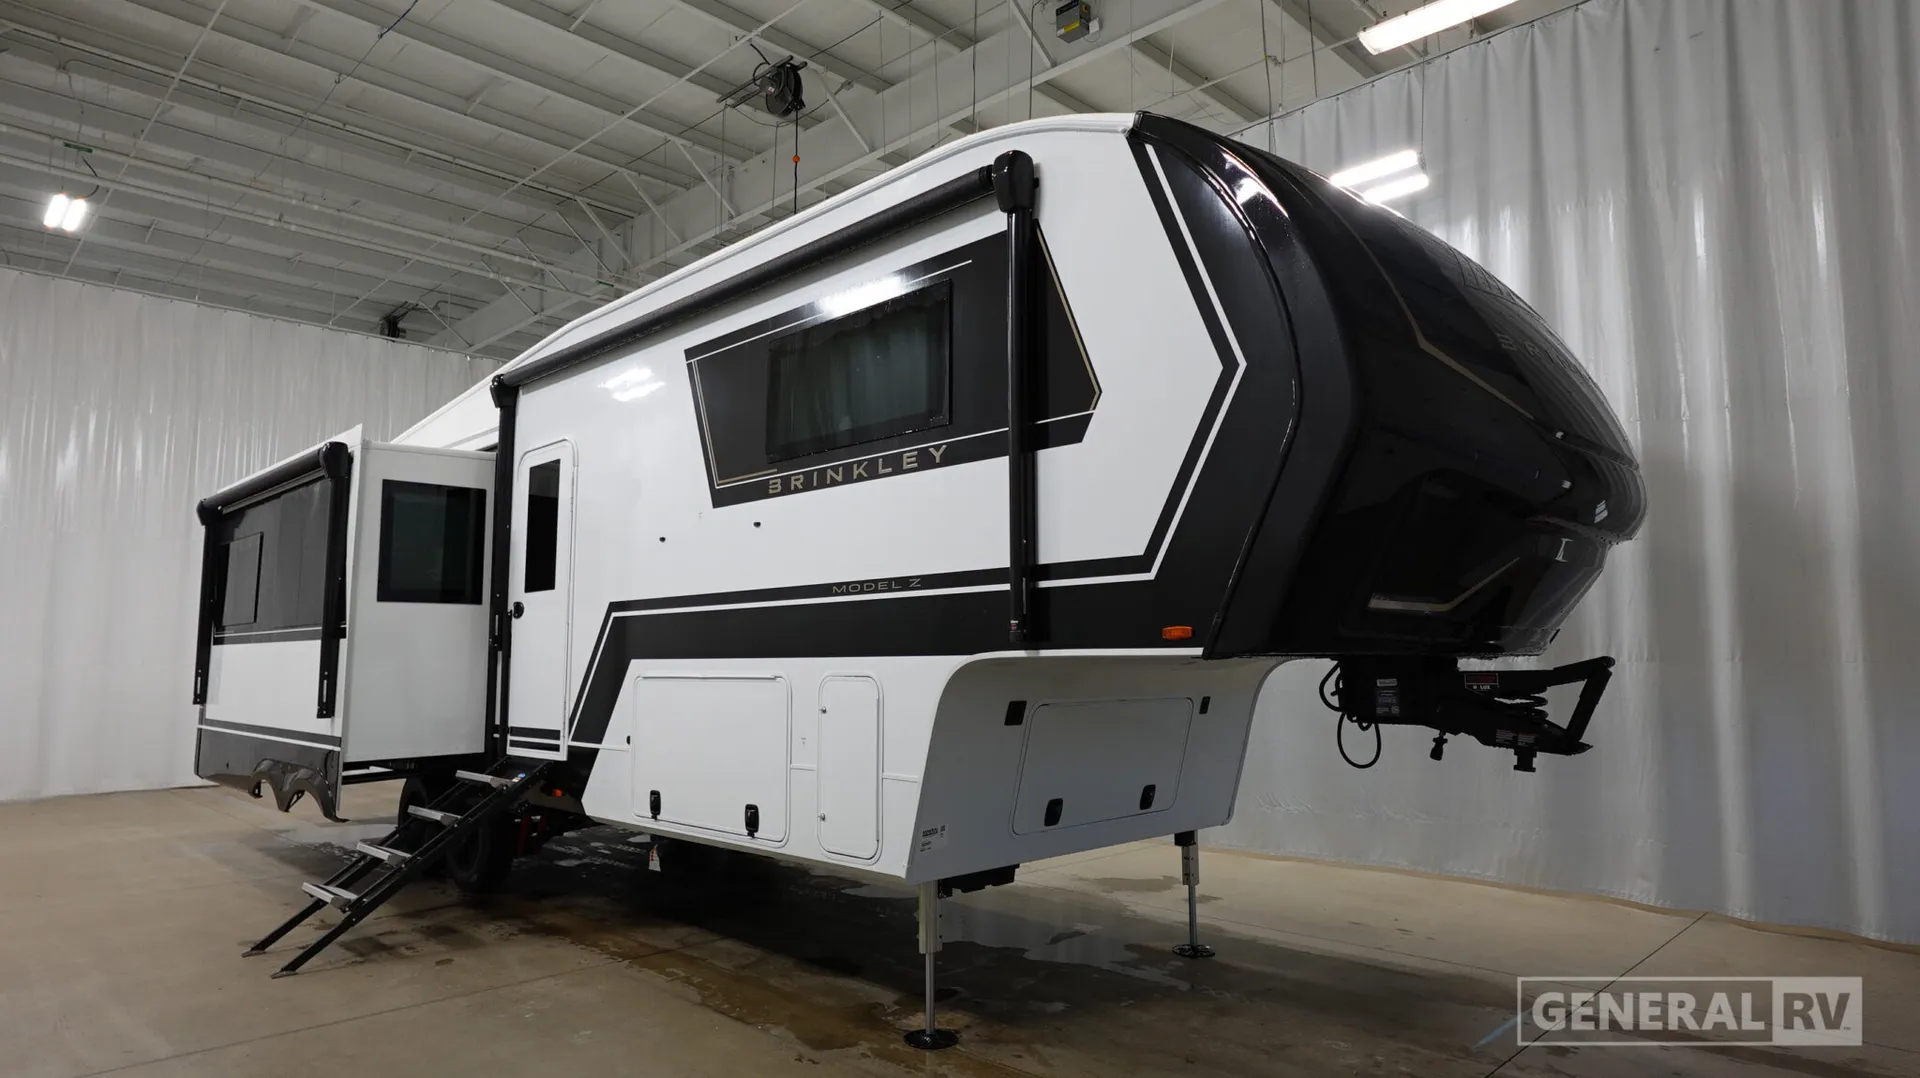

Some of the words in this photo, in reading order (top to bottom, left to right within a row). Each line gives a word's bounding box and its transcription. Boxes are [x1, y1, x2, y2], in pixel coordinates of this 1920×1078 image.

[768, 445, 947, 493] BRINKLEY
[832, 580, 902, 593] MODEL
[908, 578, 921, 588] Z
